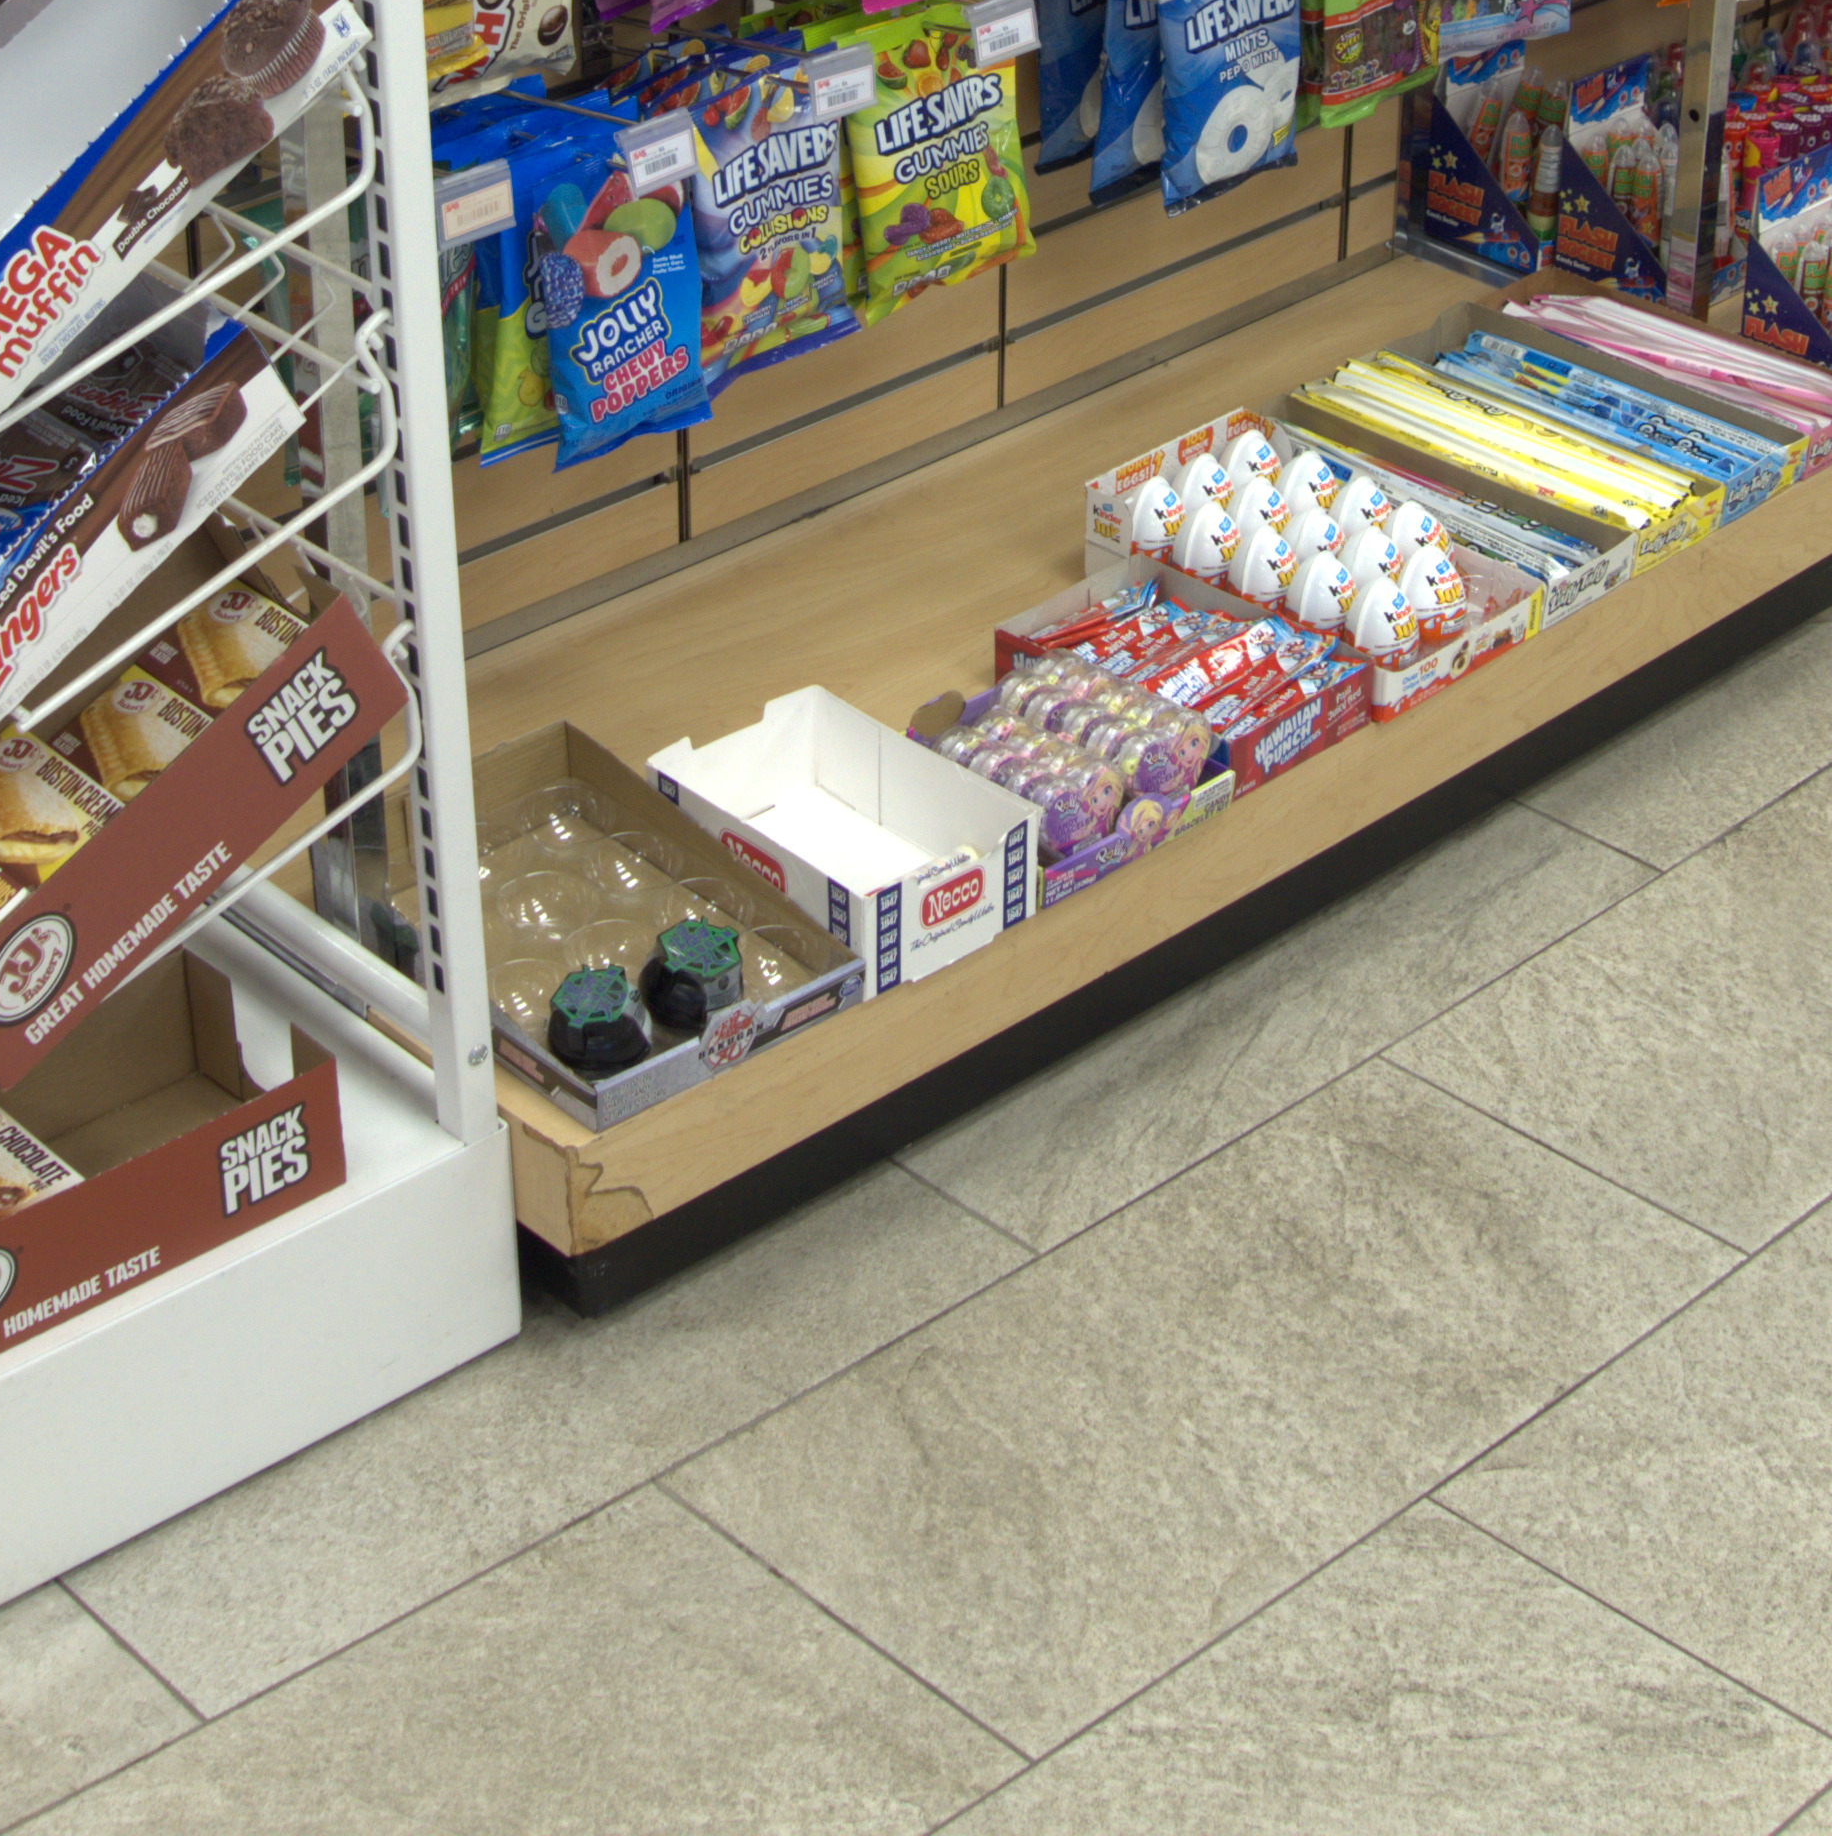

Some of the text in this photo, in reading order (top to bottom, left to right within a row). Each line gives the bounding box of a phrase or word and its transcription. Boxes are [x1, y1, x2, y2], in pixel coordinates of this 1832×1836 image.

[1224, 30, 1269, 61] MINTS
[925, 159, 980, 197] SOURS
[579, 283, 662, 361] JOLLY
[590, 349, 690, 423] POPPERS
[14, 533, 60, 589] Devil's
[56, 496, 94, 538] Food
[248, 650, 343, 740] SNACK
[1419, 660, 1439, 675] 100
[262, 678, 360, 782] PIES
[1254, 701, 1323, 765] HAWAIIAN
[926, 874, 983, 921] Necco
[221, 1107, 304, 1169] SNACK
[223, 1137, 310, 1215] PIES
[3, 1276, 101, 1337] HOMEMADE
[105, 1246, 161, 1285] TASTE
